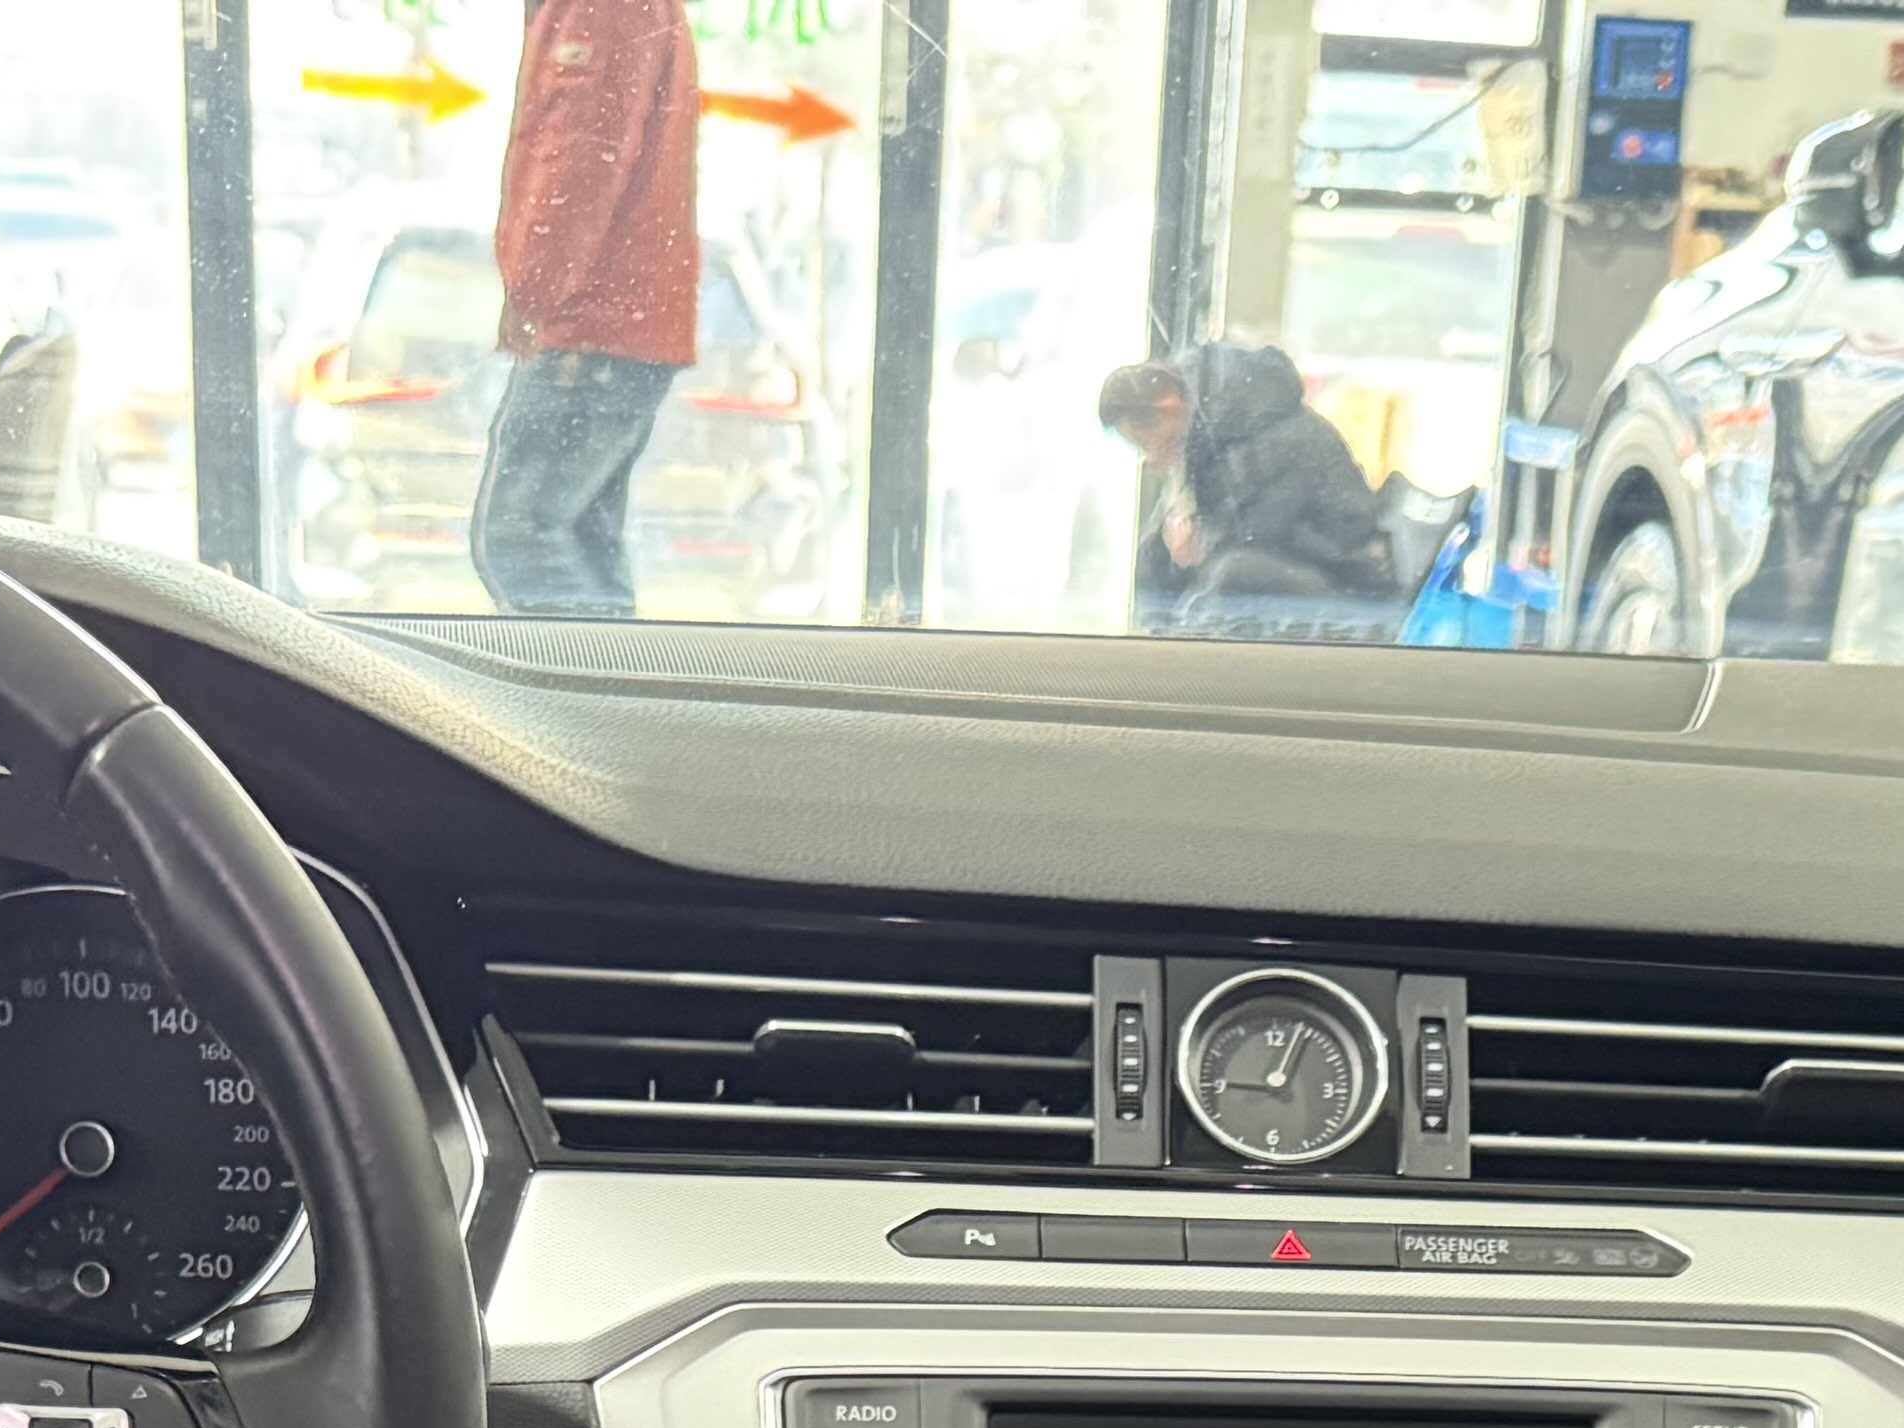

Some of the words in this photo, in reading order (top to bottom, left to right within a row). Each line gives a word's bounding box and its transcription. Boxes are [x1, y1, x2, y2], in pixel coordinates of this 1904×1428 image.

[60, 972, 110, 999] 100
[121, 980, 151, 1000] 120
[148, 1007, 196, 1034] 140
[1266, 1030, 1284, 1047] 12
[200, 1042, 230, 1061] 160
[204, 1079, 254, 1104] 180
[1215, 1079, 1226, 1094] 9
[1322, 1083, 1334, 1098] 3
[233, 1126, 269, 1144] 200
[1266, 1129, 1279, 1145] 6
[217, 1167, 270, 1192] 220
[224, 1216, 260, 1232] 240
[1404, 1236, 1509, 1254] PASSENGER
[1421, 1250, 1452, 1264] AIR
[1457, 1251, 1497, 1265] BAG
[178, 1255, 232, 1279] 260
[835, 1405, 897, 1423] RADIO
